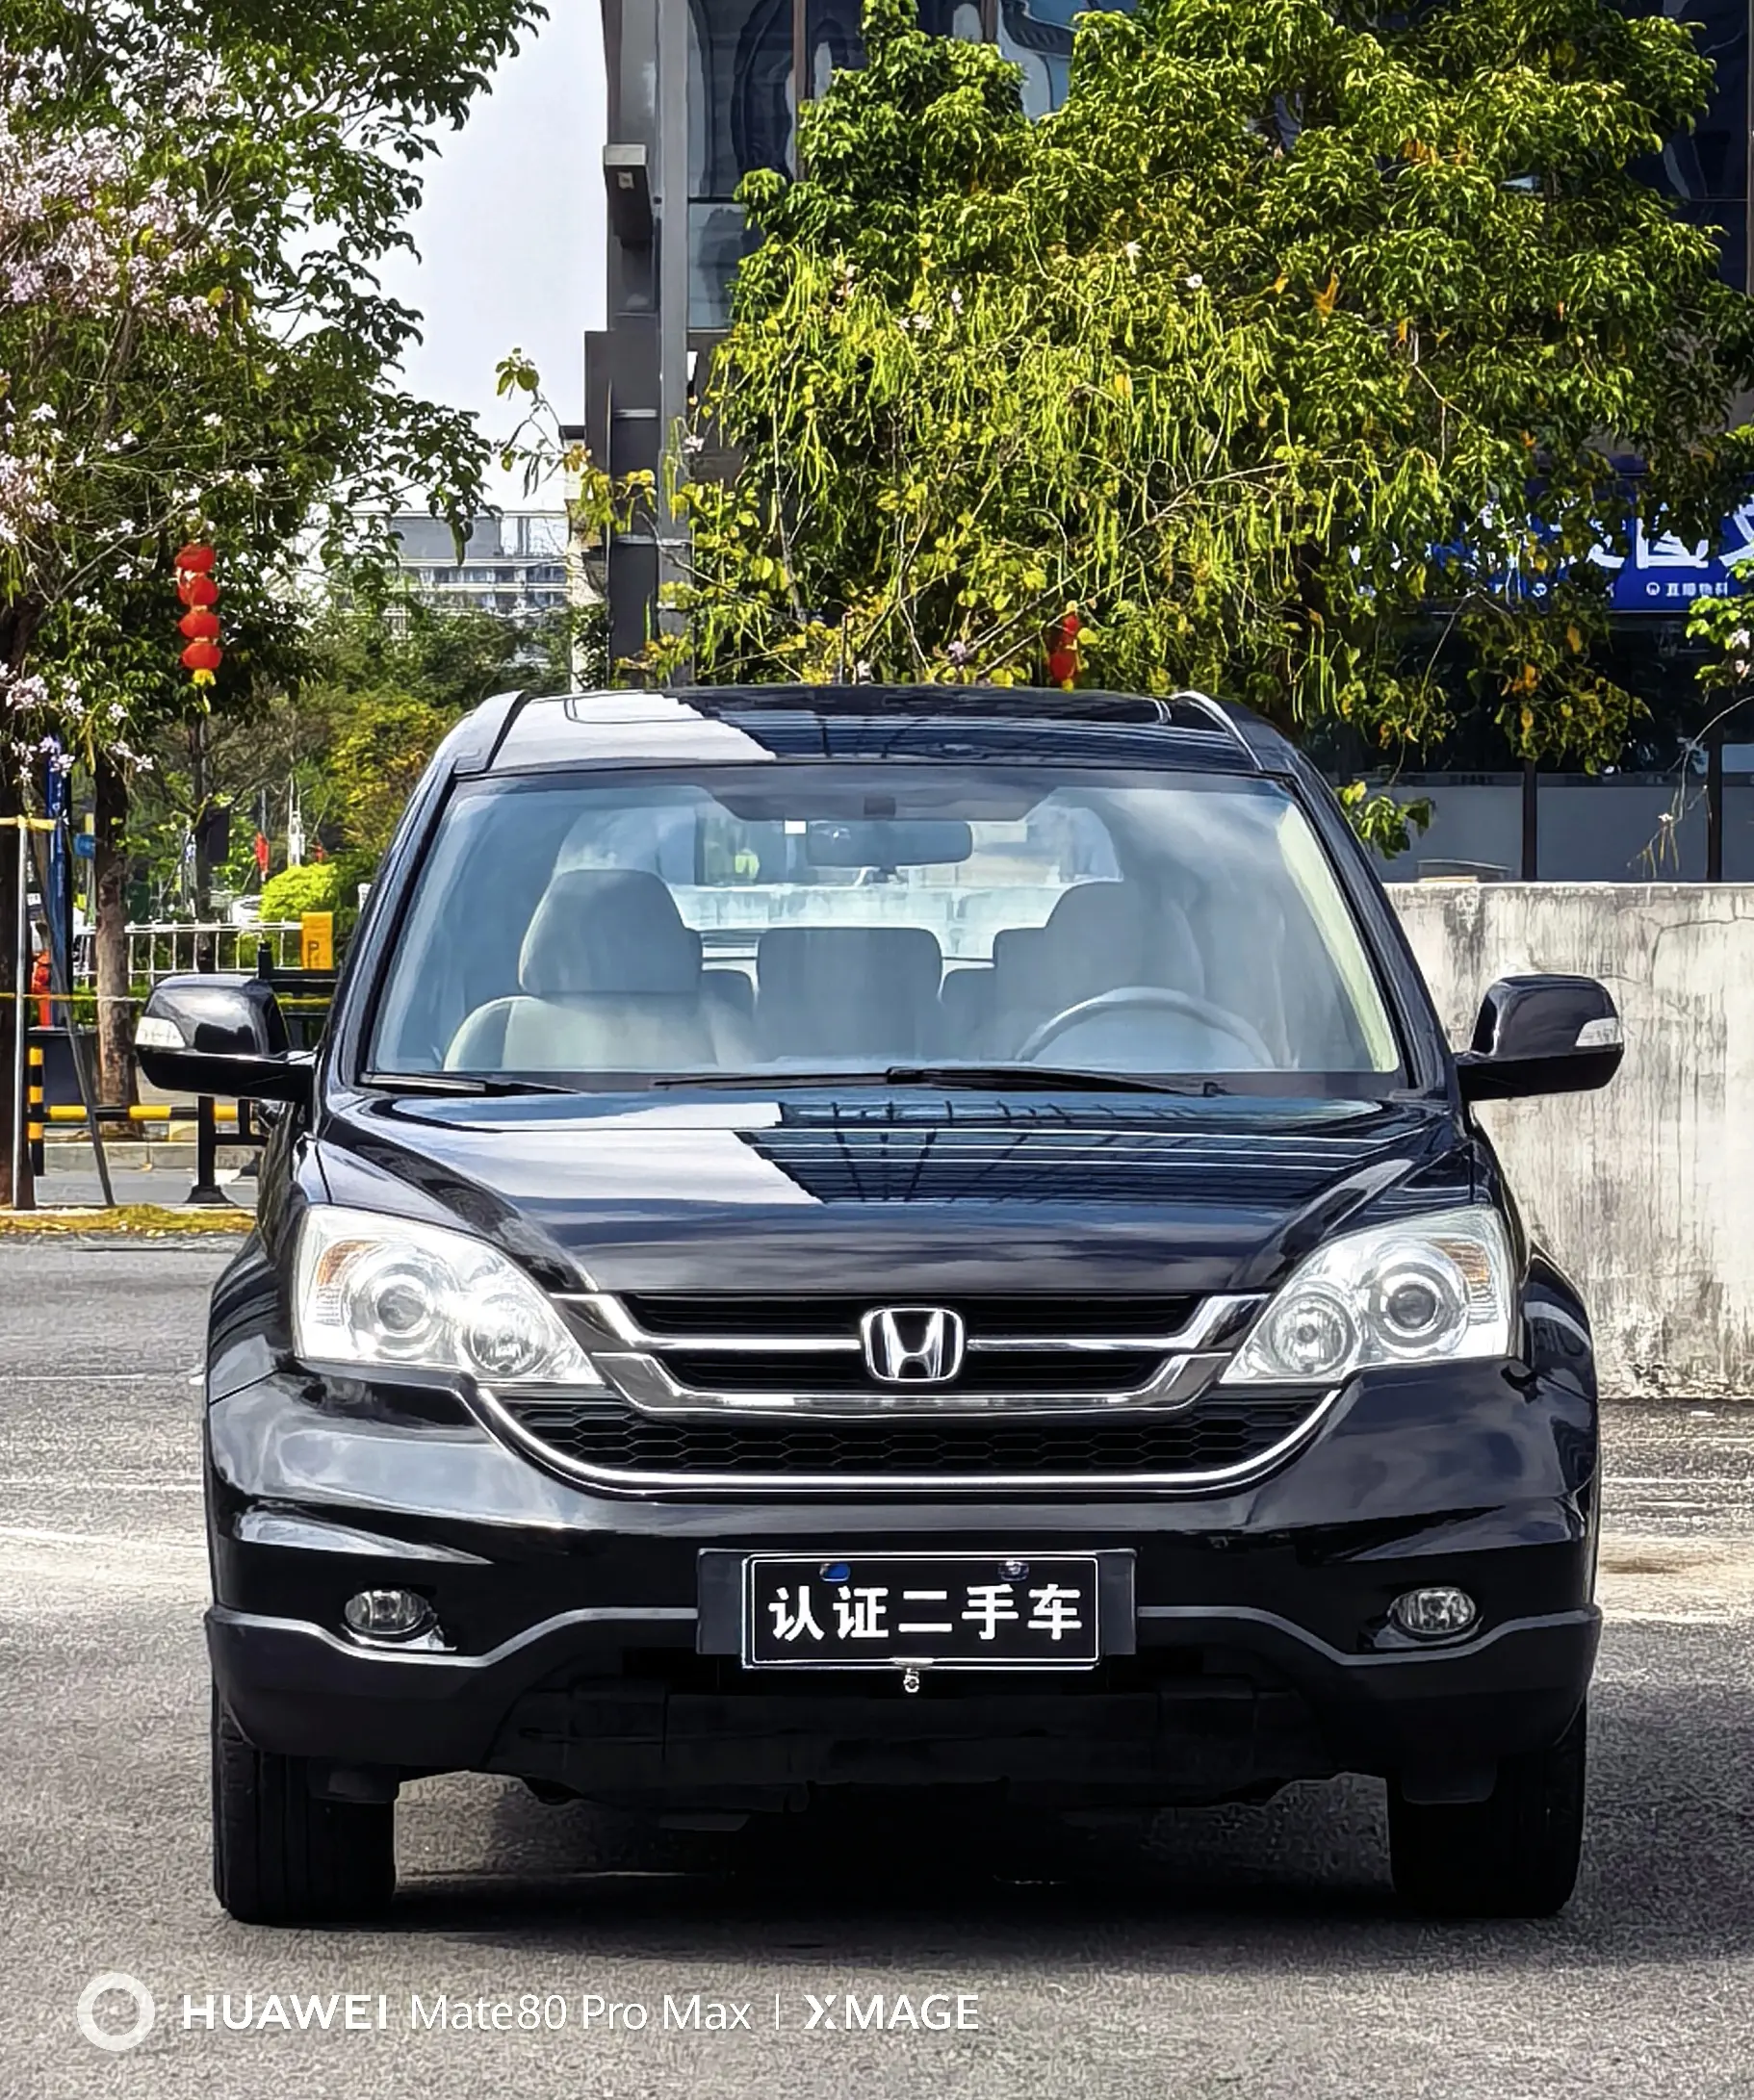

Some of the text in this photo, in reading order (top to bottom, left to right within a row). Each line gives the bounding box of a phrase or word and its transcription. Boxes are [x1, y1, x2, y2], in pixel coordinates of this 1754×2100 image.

[768, 1583, 1082, 1642] 认证二手车
